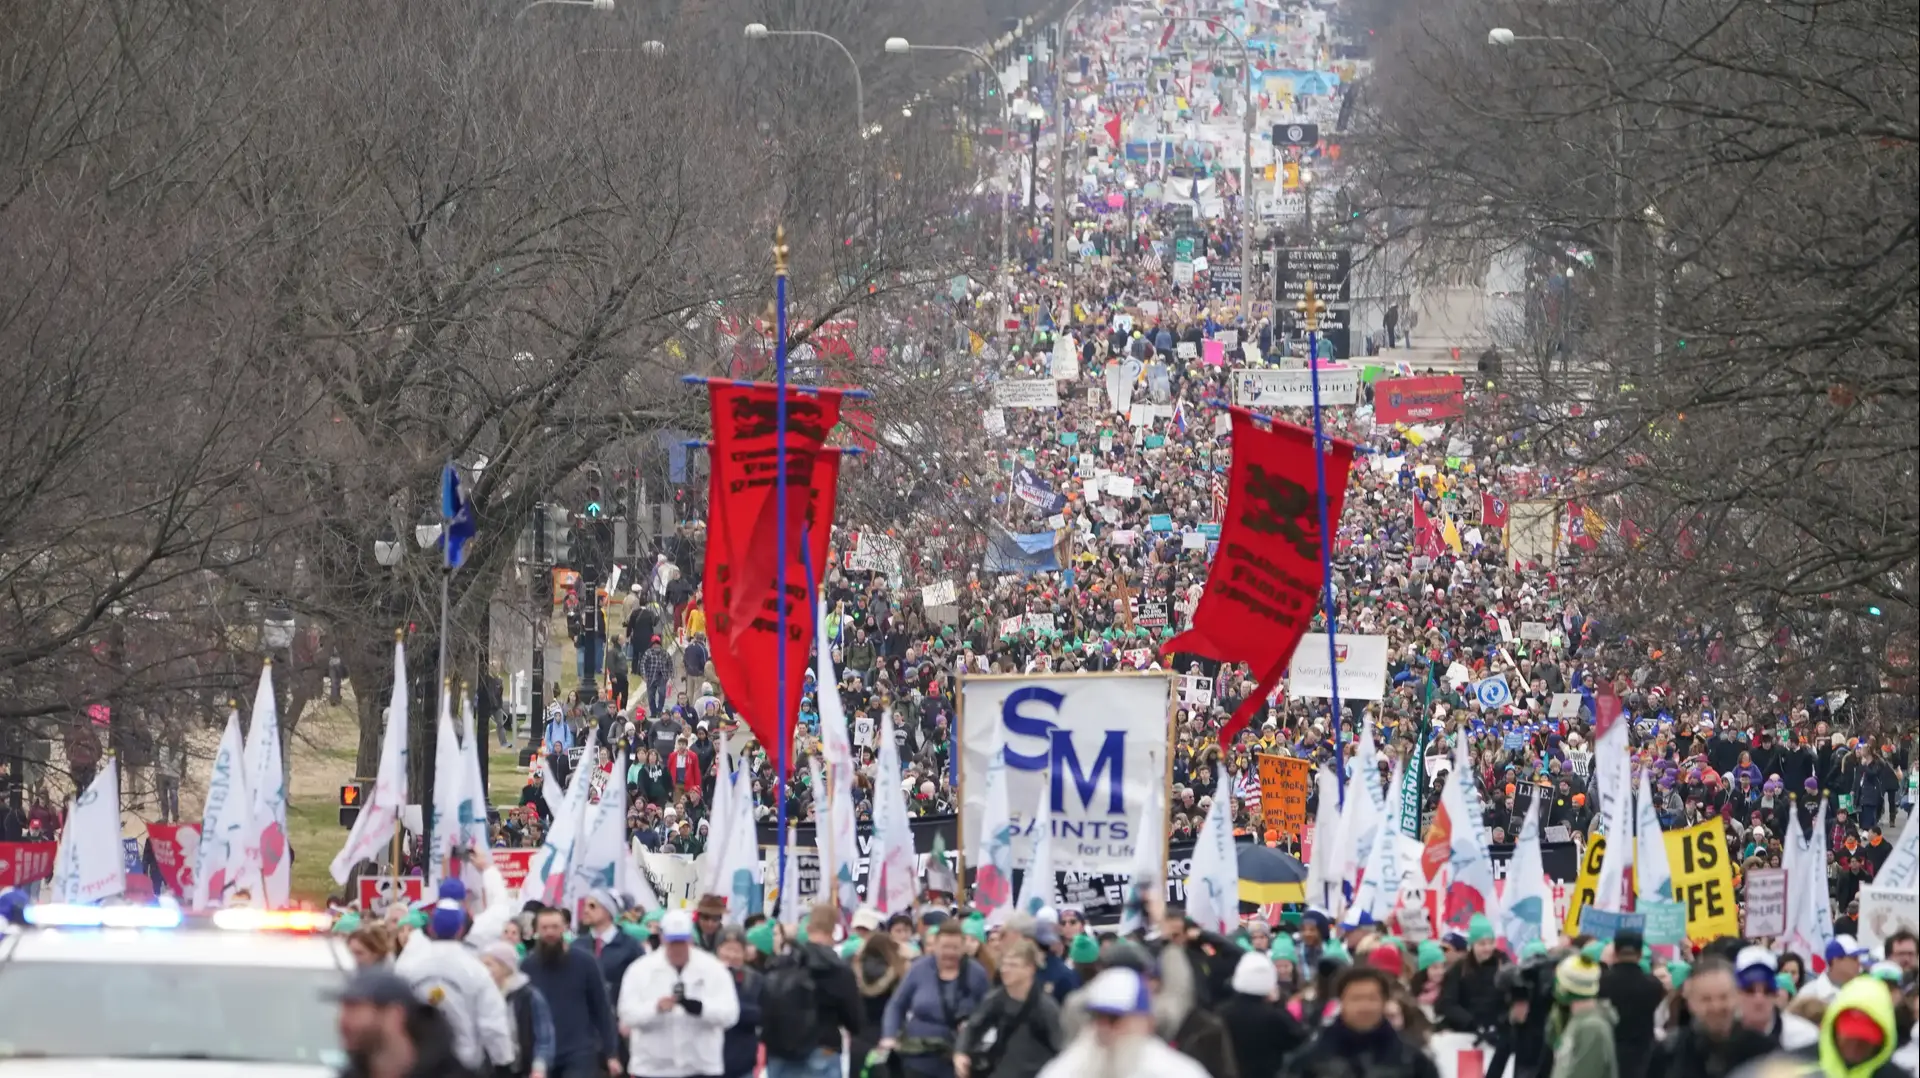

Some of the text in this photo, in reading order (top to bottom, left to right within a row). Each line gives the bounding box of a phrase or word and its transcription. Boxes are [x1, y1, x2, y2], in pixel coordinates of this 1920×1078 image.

[1289, 252, 1301, 260] GET
[1265, 383, 1353, 393] CUA is PR-LIFE!
[1297, 666, 1316, 675] Saint
[1343, 669, 1379, 680] Seminary
[1262, 777, 1276, 785] ALL
[1518, 784, 1551, 800] LIE.
[1078, 843, 1100, 856] for
[1682, 831, 1717, 874] IS
[1676, 879, 1724, 922] IFE
[1870, 892, 1917, 902] CHOOSE
